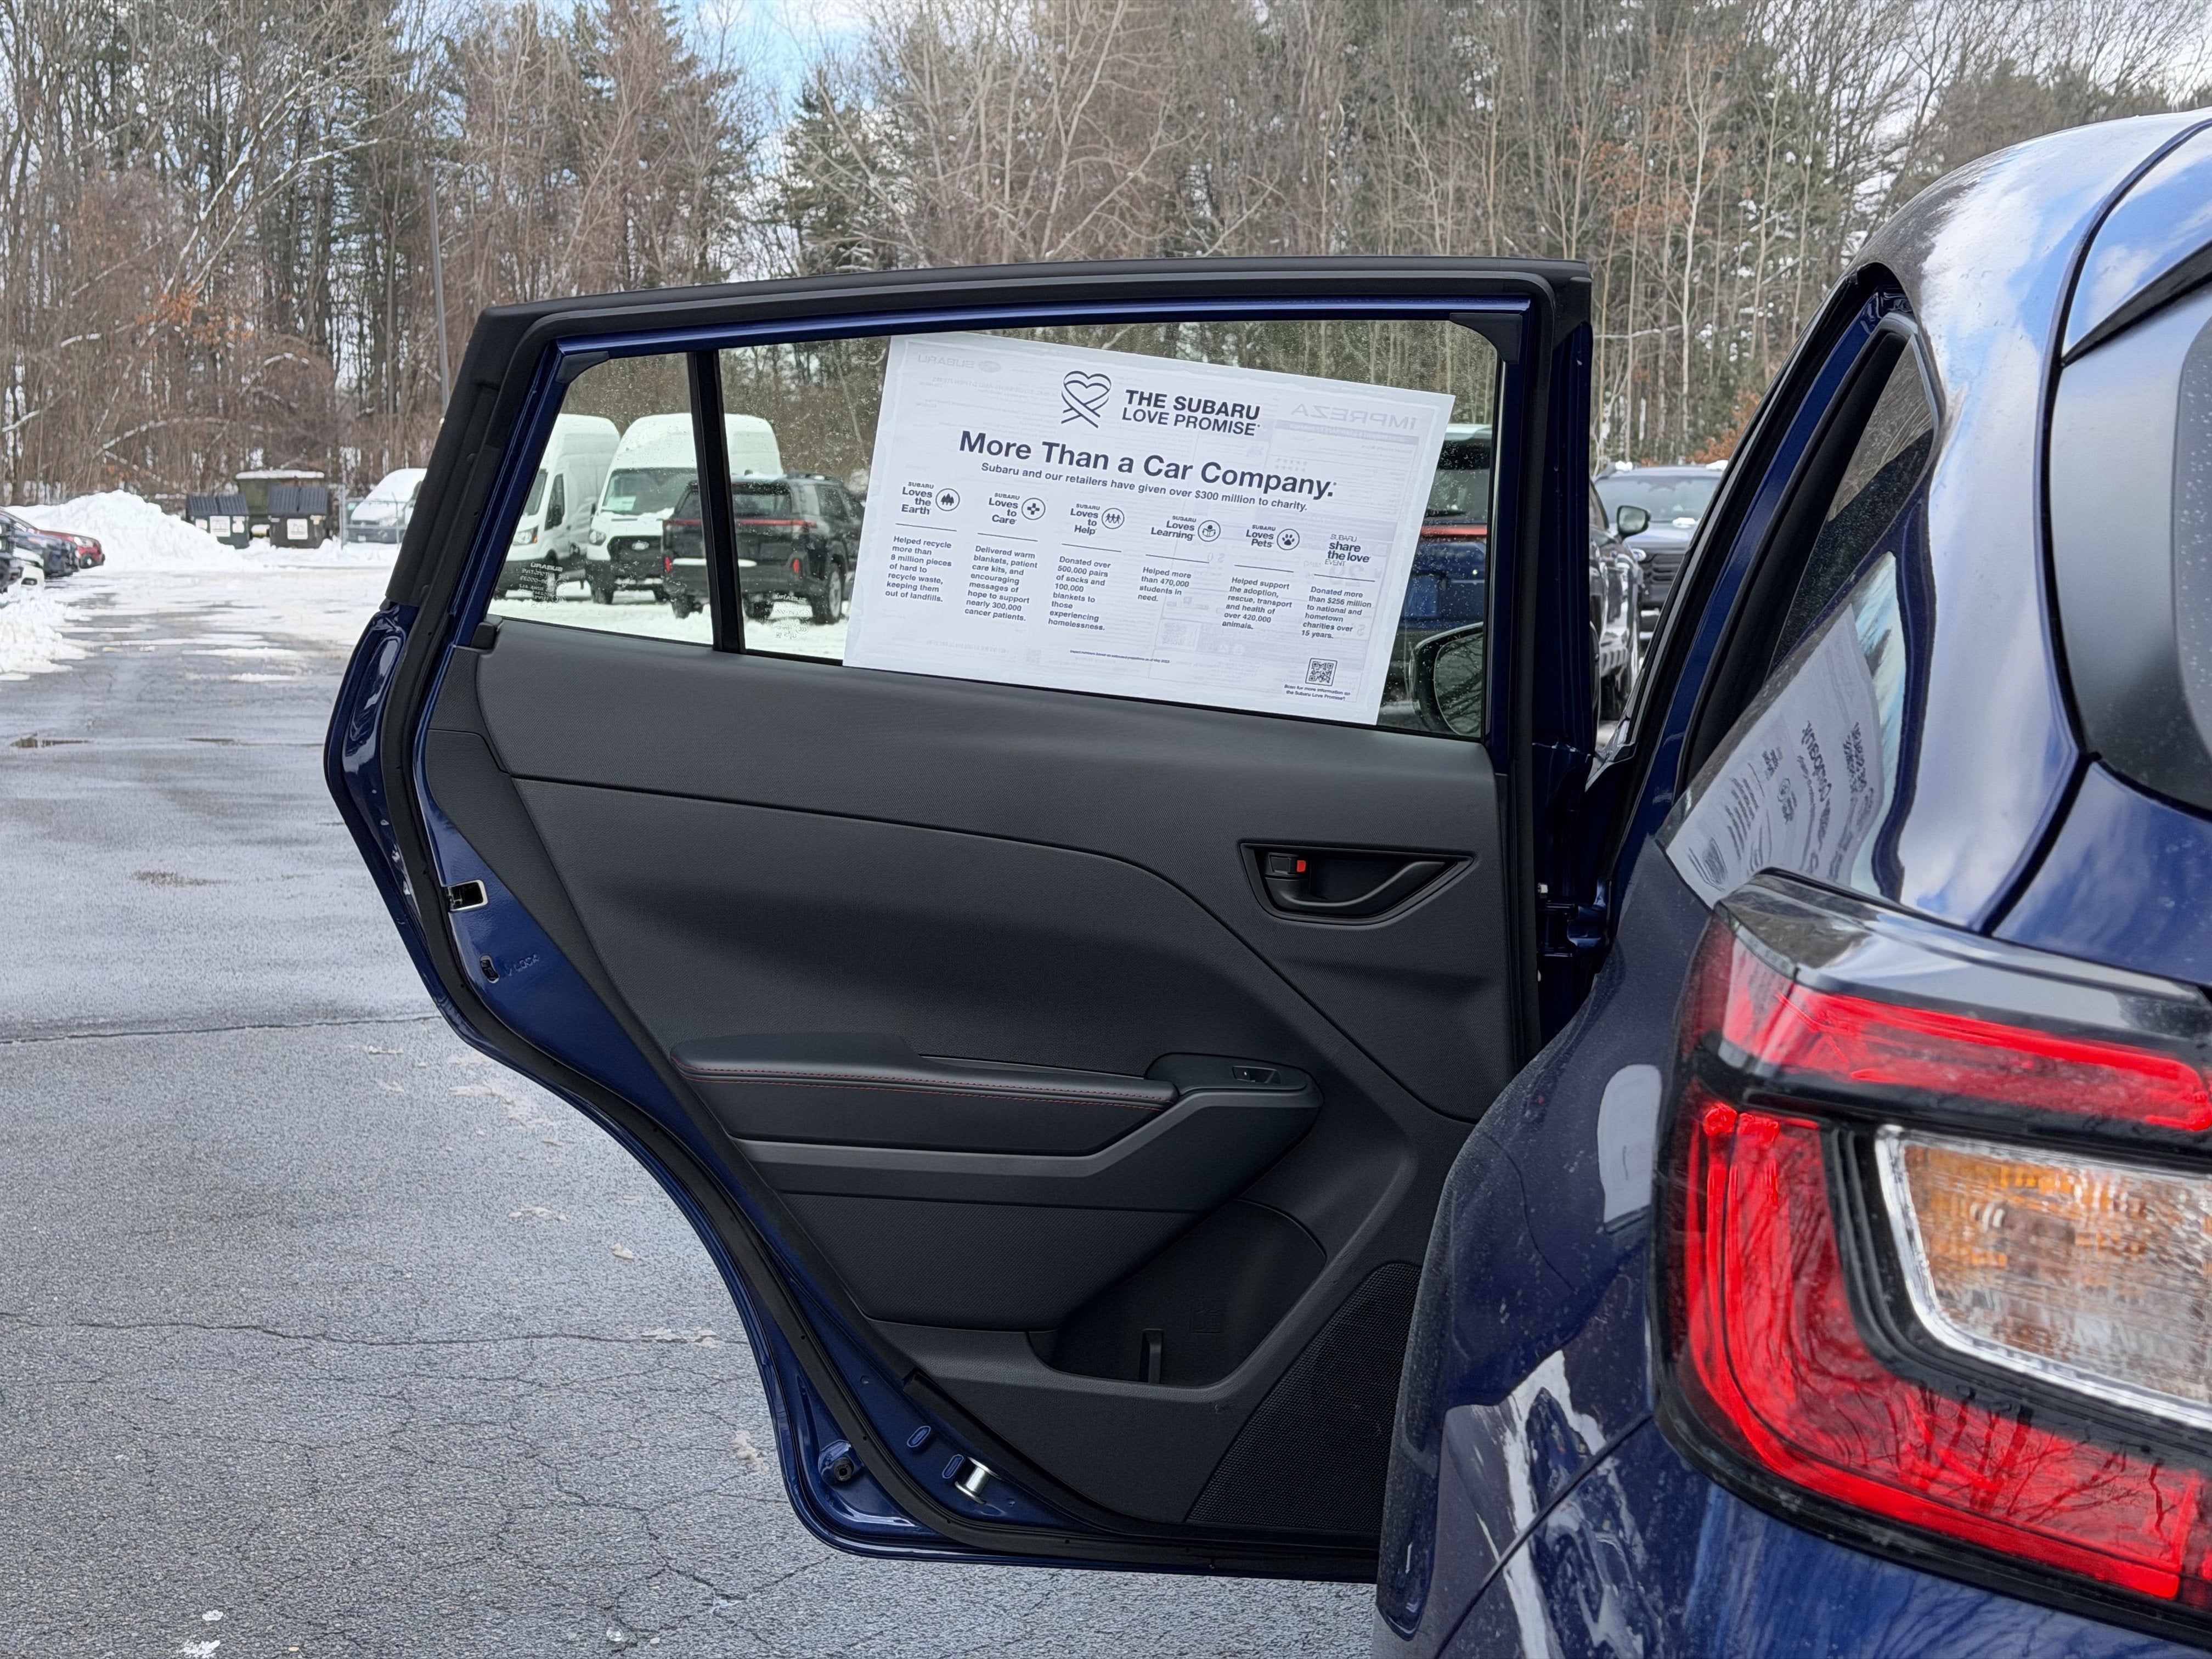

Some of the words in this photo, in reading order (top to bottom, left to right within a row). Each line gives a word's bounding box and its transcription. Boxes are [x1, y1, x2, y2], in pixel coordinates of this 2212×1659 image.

[1126, 390, 1167, 409] THE
[1173, 396, 1260, 420] SUBARU
[1122, 407, 1170, 425] LOVE
[960, 431, 1031, 460] More
[1042, 441, 1109, 470] Than
[1118, 457, 1134, 473] a
[1144, 455, 1193, 480] Car
[902, 487, 933, 498] Loves
[981, 462, 1019, 475] Subaru
[1022, 470, 1042, 478] and
[1065, 476, 1108, 487] retailers
[1110, 479, 1135, 490] have
[1138, 484, 1166, 494] given
[1169, 489, 1192, 497] over
[1195, 490, 1218, 500] $300
[1221, 494, 1255, 504] million
[1259, 498, 1268, 506] to
[1271, 499, 1307, 512] charity.
[915, 497, 932, 506] the
[989, 498, 1018, 509] Loves
[1070, 508, 1098, 518] Loves
[1166, 520, 1195, 531] Loves
[1246, 529, 1274, 540] Loves
[1330, 534, 1357, 542] SUBARU
[894, 536, 921, 545] Helped
[923, 540, 952, 549] recycle
[1329, 541, 1361, 552] share
[975, 545, 1012, 556] Delivered
[1328, 550, 1346, 560] the
[898, 555, 924, 563] million
[926, 558, 952, 566] pieces
[973, 554, 1008, 566] blankets,
[1011, 560, 1037, 568] patient
[1059, 556, 1092, 566] Donated
[991, 565, 1007, 574] kits,
[1057, 565, 1087, 574] 500,000
[1143, 567, 1170, 576] Helped
[918, 576, 943, 585] waste,
[970, 573, 1019, 585] encouraging
[1141, 575, 1158, 584] than
[1160, 578, 1189, 587] 470,000
[1232, 577, 1258, 586] Helped
[1260, 582, 1289, 590] support
[887, 580, 918, 591] keeping
[919, 584, 939, 592] them
[969, 582, 1008, 592] messages
[1055, 583, 1084, 592] 100,000
[1139, 585, 1172, 594] students
[1310, 586, 1342, 596] Donated
[910, 592, 943, 602] landfills.
[968, 590, 988, 599] hope
[999, 595, 1030, 603] support
[1053, 591, 1085, 601] blankets
[1243, 588, 1279, 599] adoption,
[966, 600, 990, 608] nearly
[992, 602, 1022, 611] 300,000
[1052, 601, 1073, 609] those
[1228, 595, 1255, 604] rescue,
[1257, 598, 1293, 608] transport
[1346, 600, 1372, 608] million
[1242, 605, 1265, 613] health
[992, 612, 1026, 621] patients.
[1049, 611, 1099, 623] experiencing
[1242, 614, 1271, 623] 420,000
[1305, 612, 1344, 623] hometown
[1048, 618, 1105, 630] homelessness.
[1222, 620, 1254, 629] animals.
[1302, 621, 1335, 630] charities
